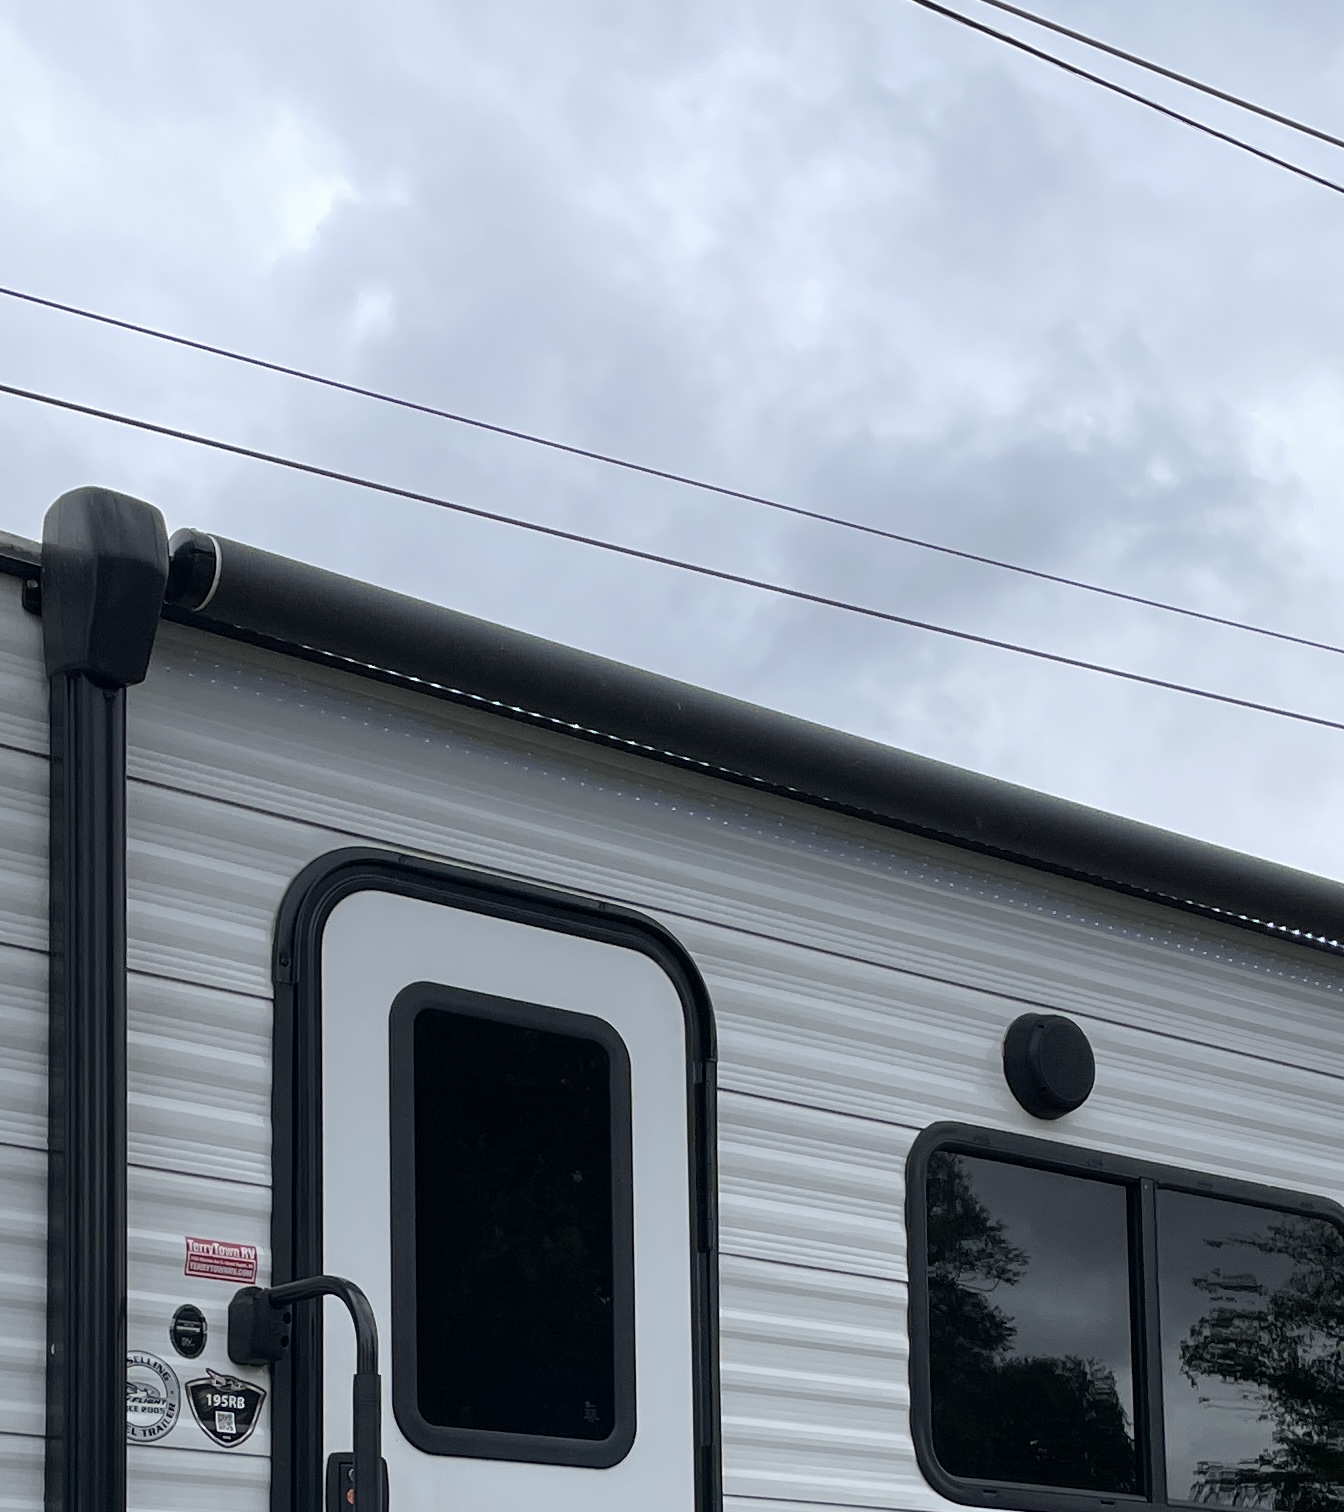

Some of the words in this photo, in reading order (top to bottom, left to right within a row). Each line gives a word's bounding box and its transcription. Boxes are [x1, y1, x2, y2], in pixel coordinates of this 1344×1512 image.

[240, 1246, 255, 1259] RV
[205, 1393, 245, 1410] 195RB
[141, 1402, 176, 1438] TRAILER
